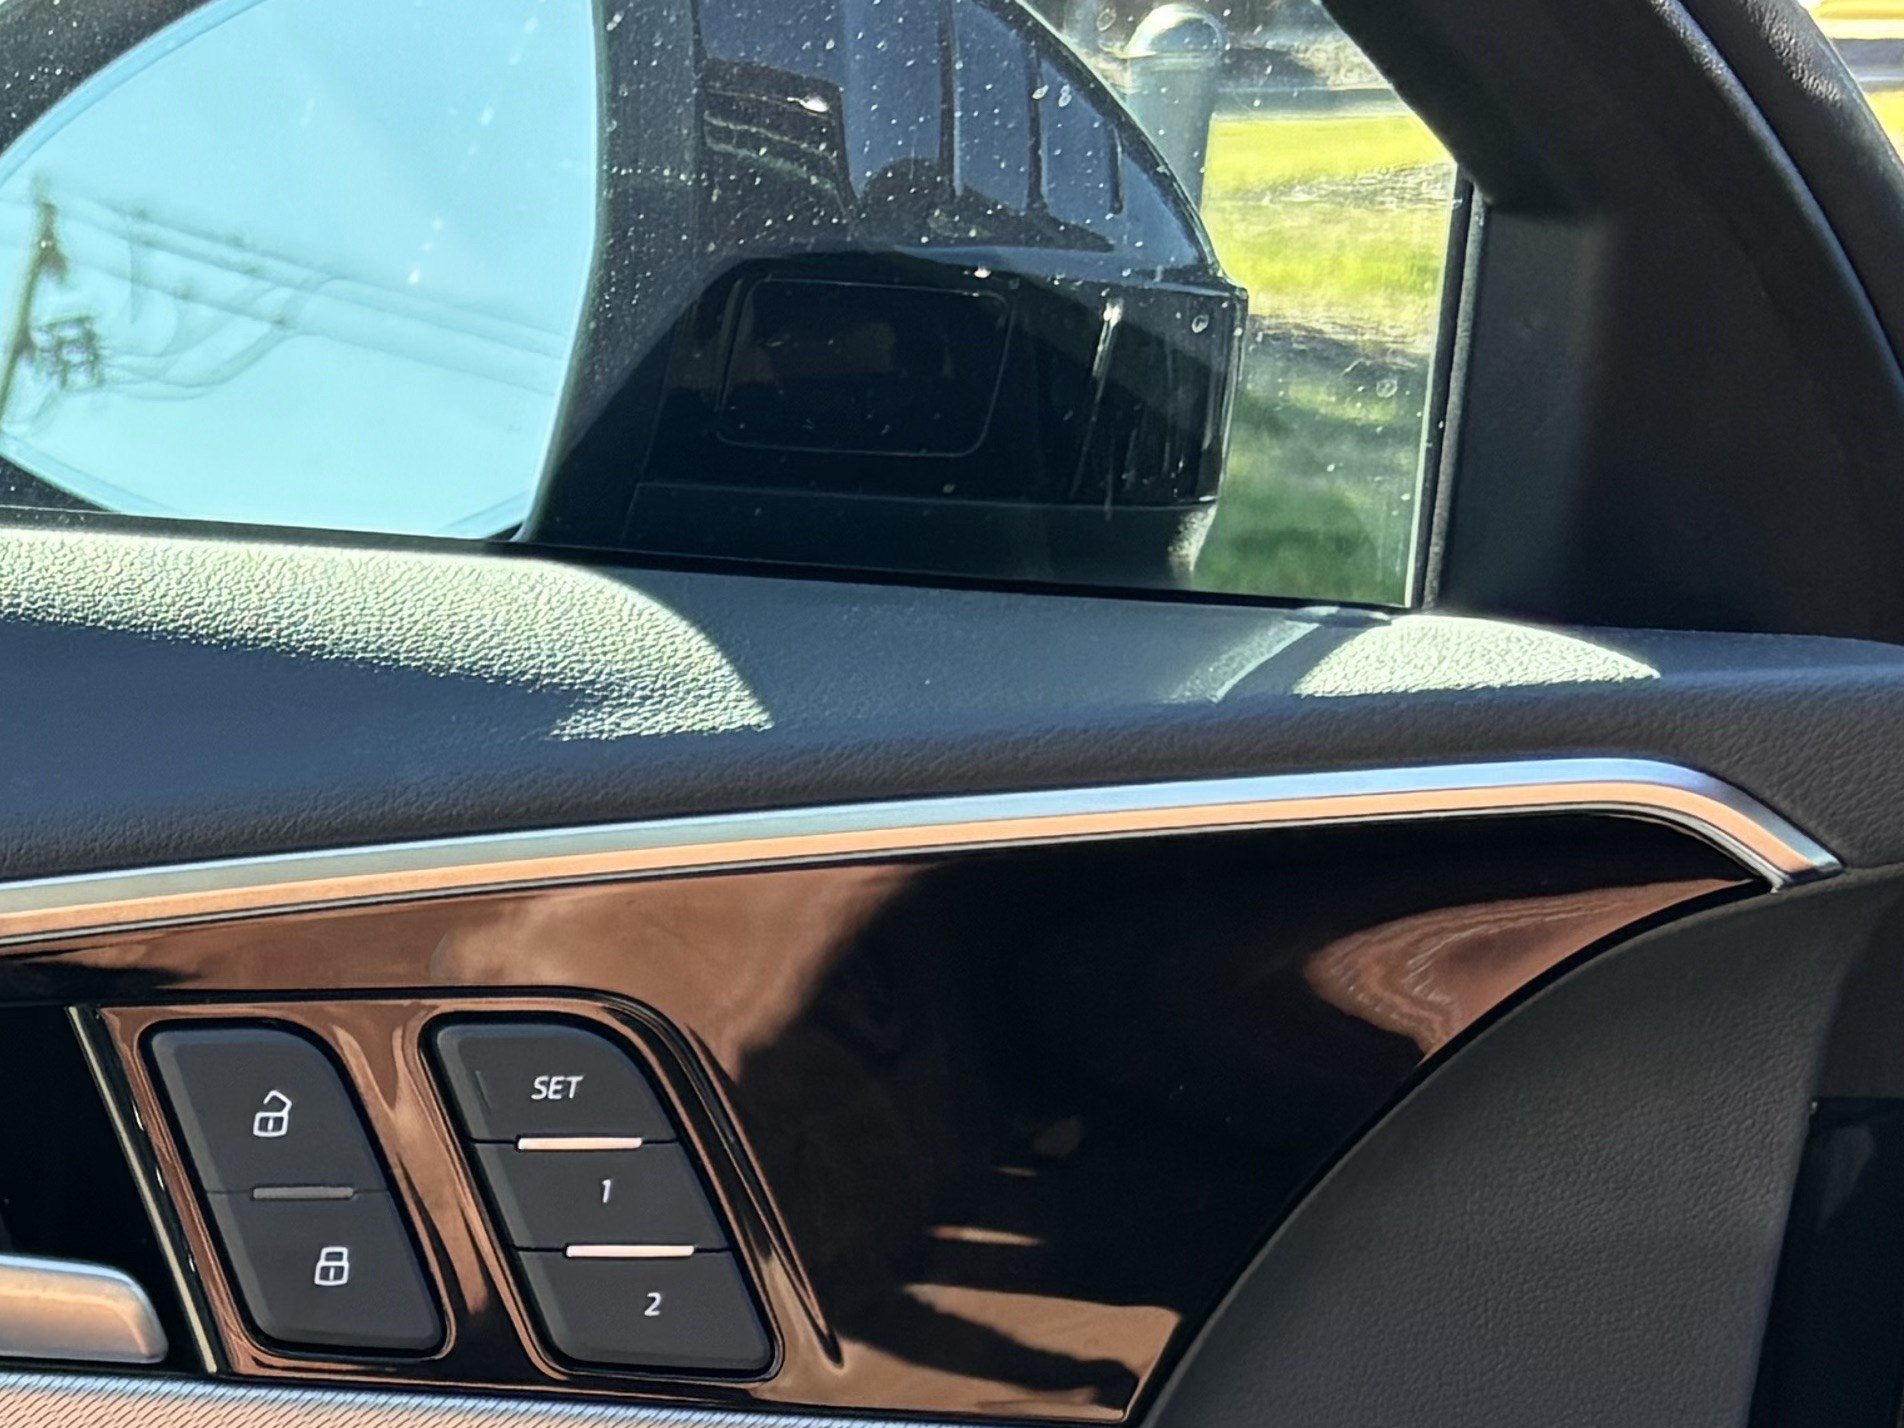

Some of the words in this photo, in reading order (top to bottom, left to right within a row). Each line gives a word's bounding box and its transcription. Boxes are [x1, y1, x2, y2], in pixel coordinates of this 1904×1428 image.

[531, 1076, 583, 1099] SET
[601, 1179, 612, 1203] 1
[644, 1292, 662, 1316] 2
